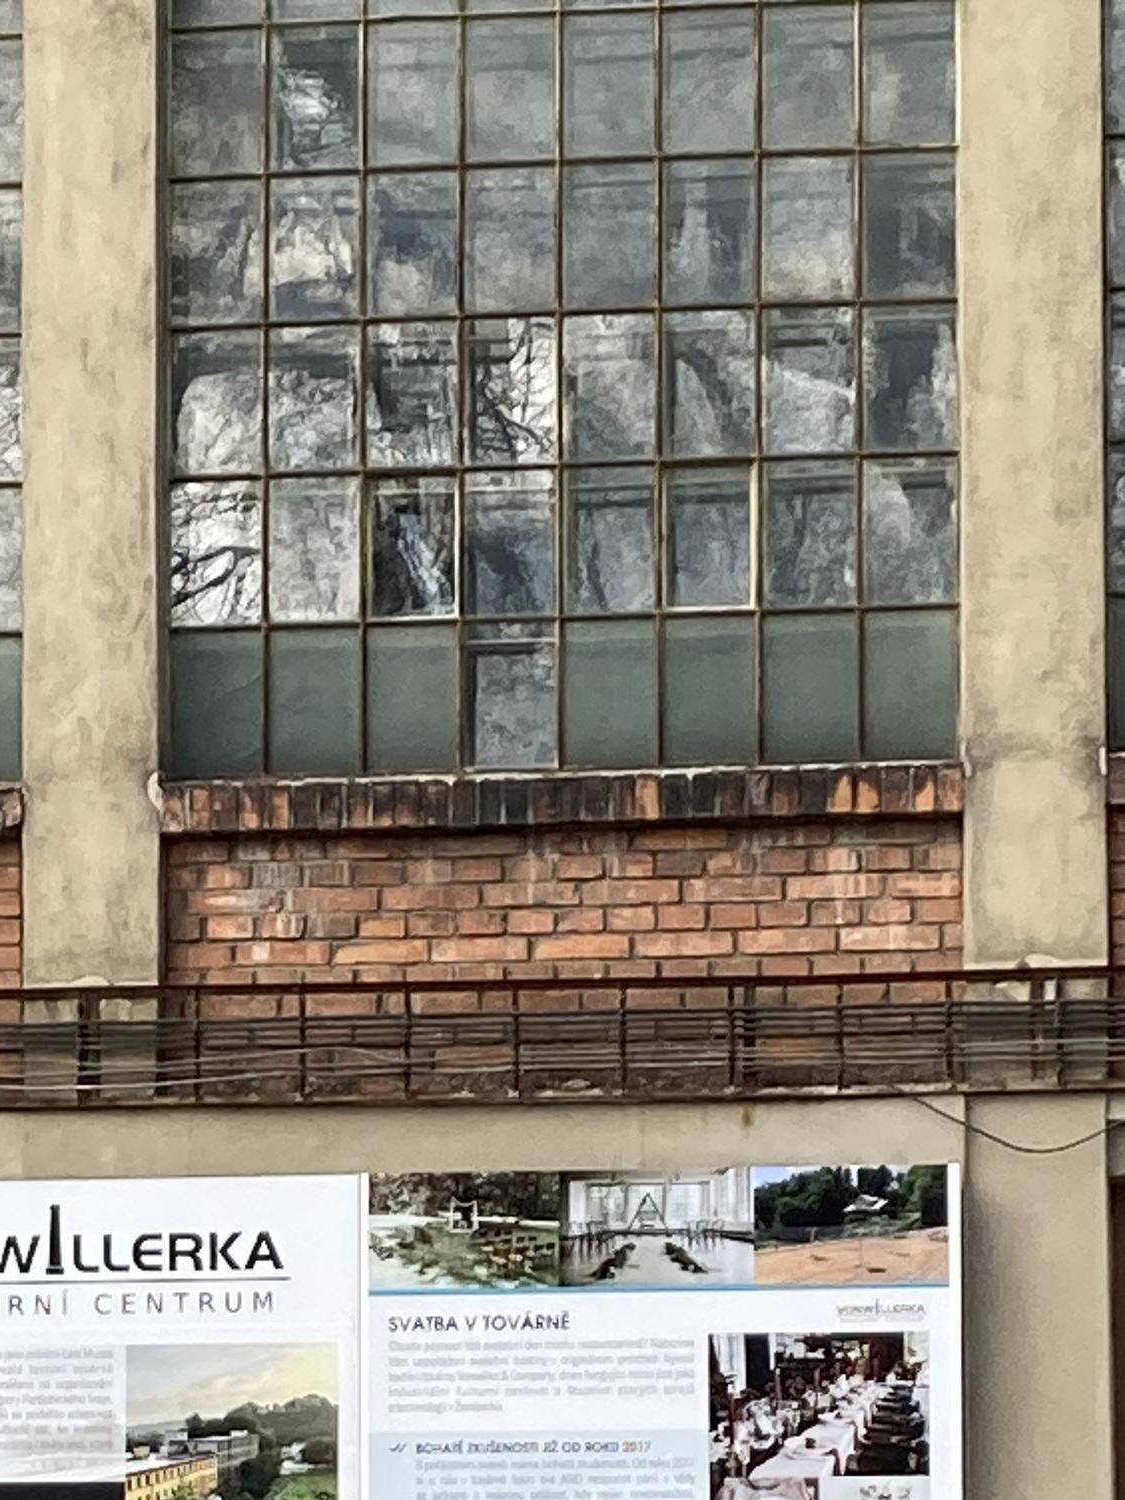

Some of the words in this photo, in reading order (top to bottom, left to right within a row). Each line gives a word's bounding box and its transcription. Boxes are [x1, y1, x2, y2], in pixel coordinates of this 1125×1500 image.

[94, 1290, 275, 1317] CENTRUM
[388, 1315, 458, 1333] SVATBA
[465, 1315, 479, 1331] V
[483, 1310, 571, 1331] TOVÁRNĚ
[561, 1441, 581, 1453] OD
